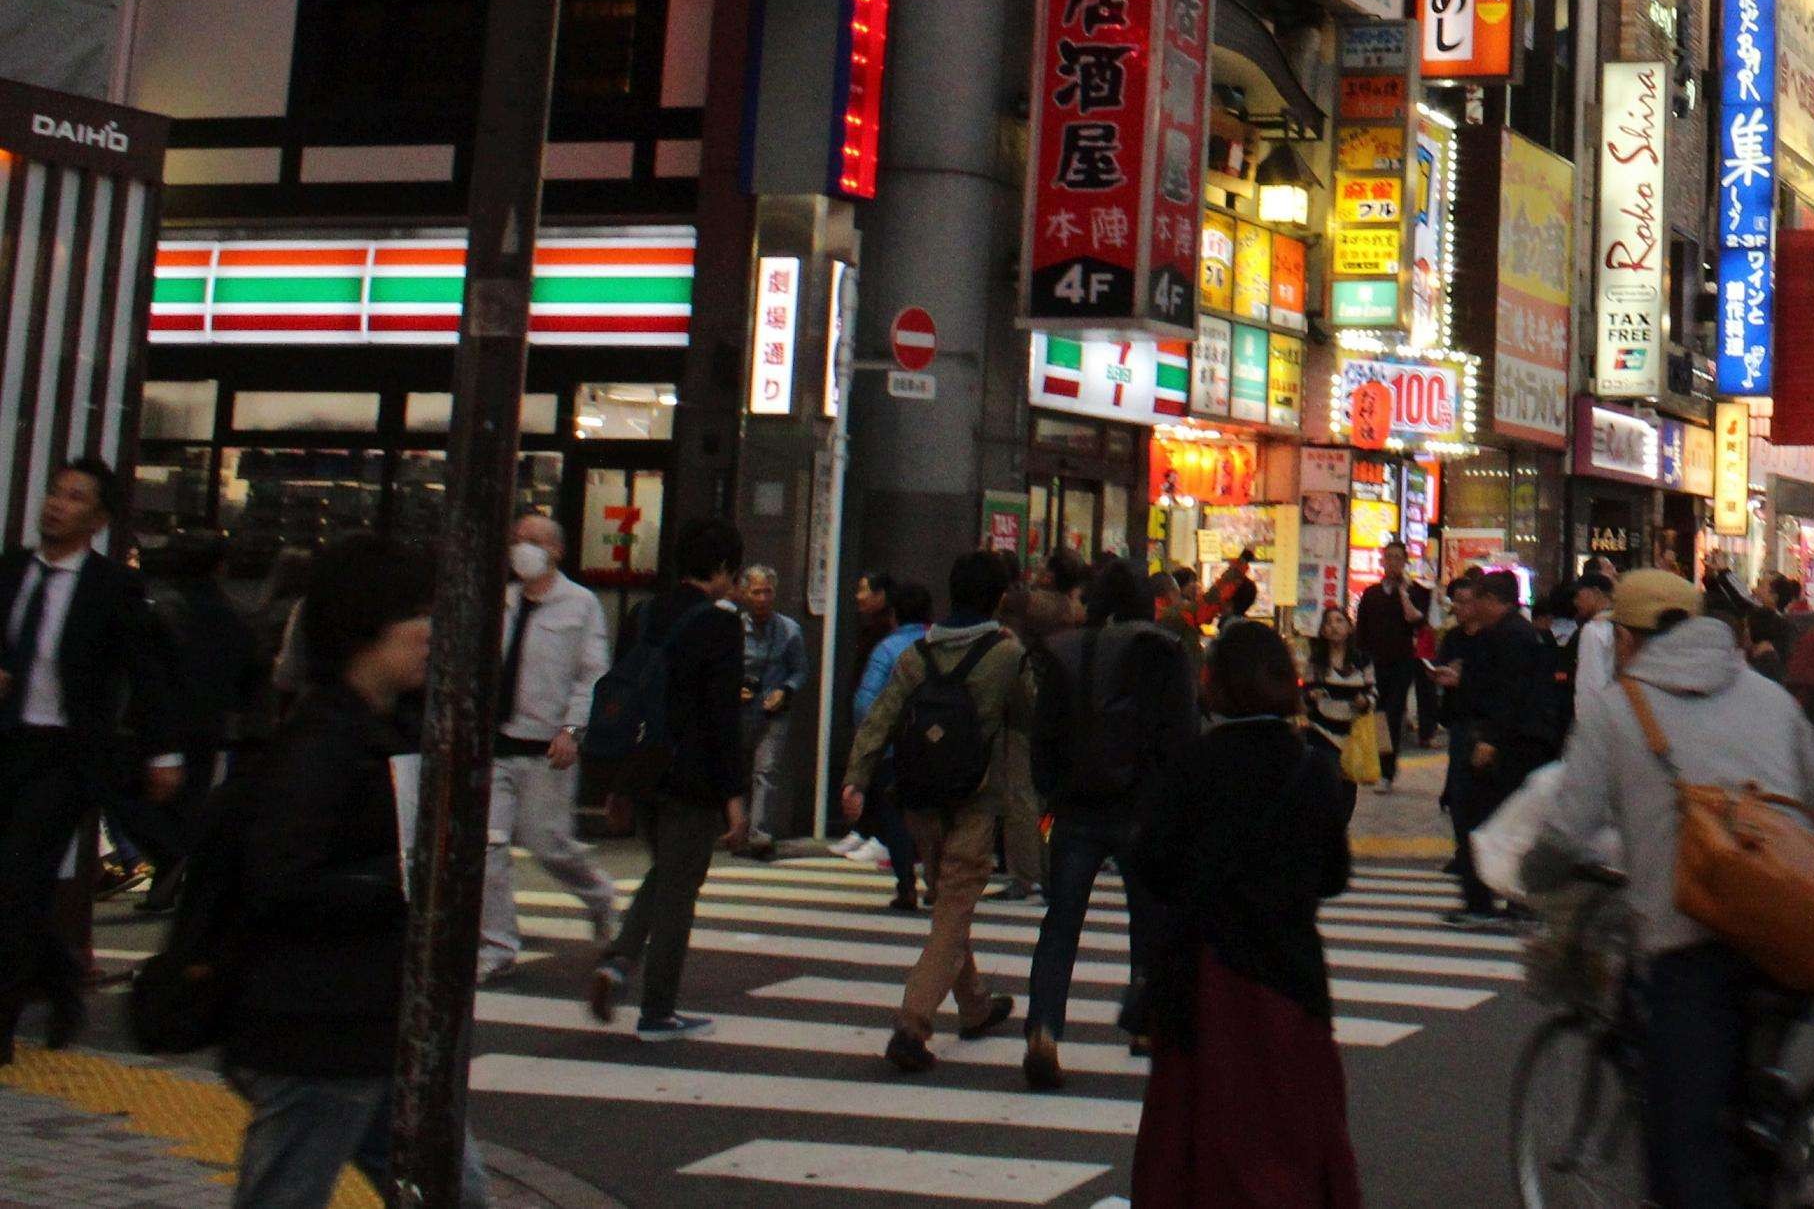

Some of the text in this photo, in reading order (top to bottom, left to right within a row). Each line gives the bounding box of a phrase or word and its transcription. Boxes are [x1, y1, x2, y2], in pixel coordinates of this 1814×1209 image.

[1046, 206, 1130, 249] 本陣
[1054, 263, 1115, 305] 4F
[1153, 271, 1183, 315] 4F
[1746, 251, 1767, 326] ワインと
[1607, 312, 1651, 327] TAX
[1608, 327, 1652, 343] FREE
